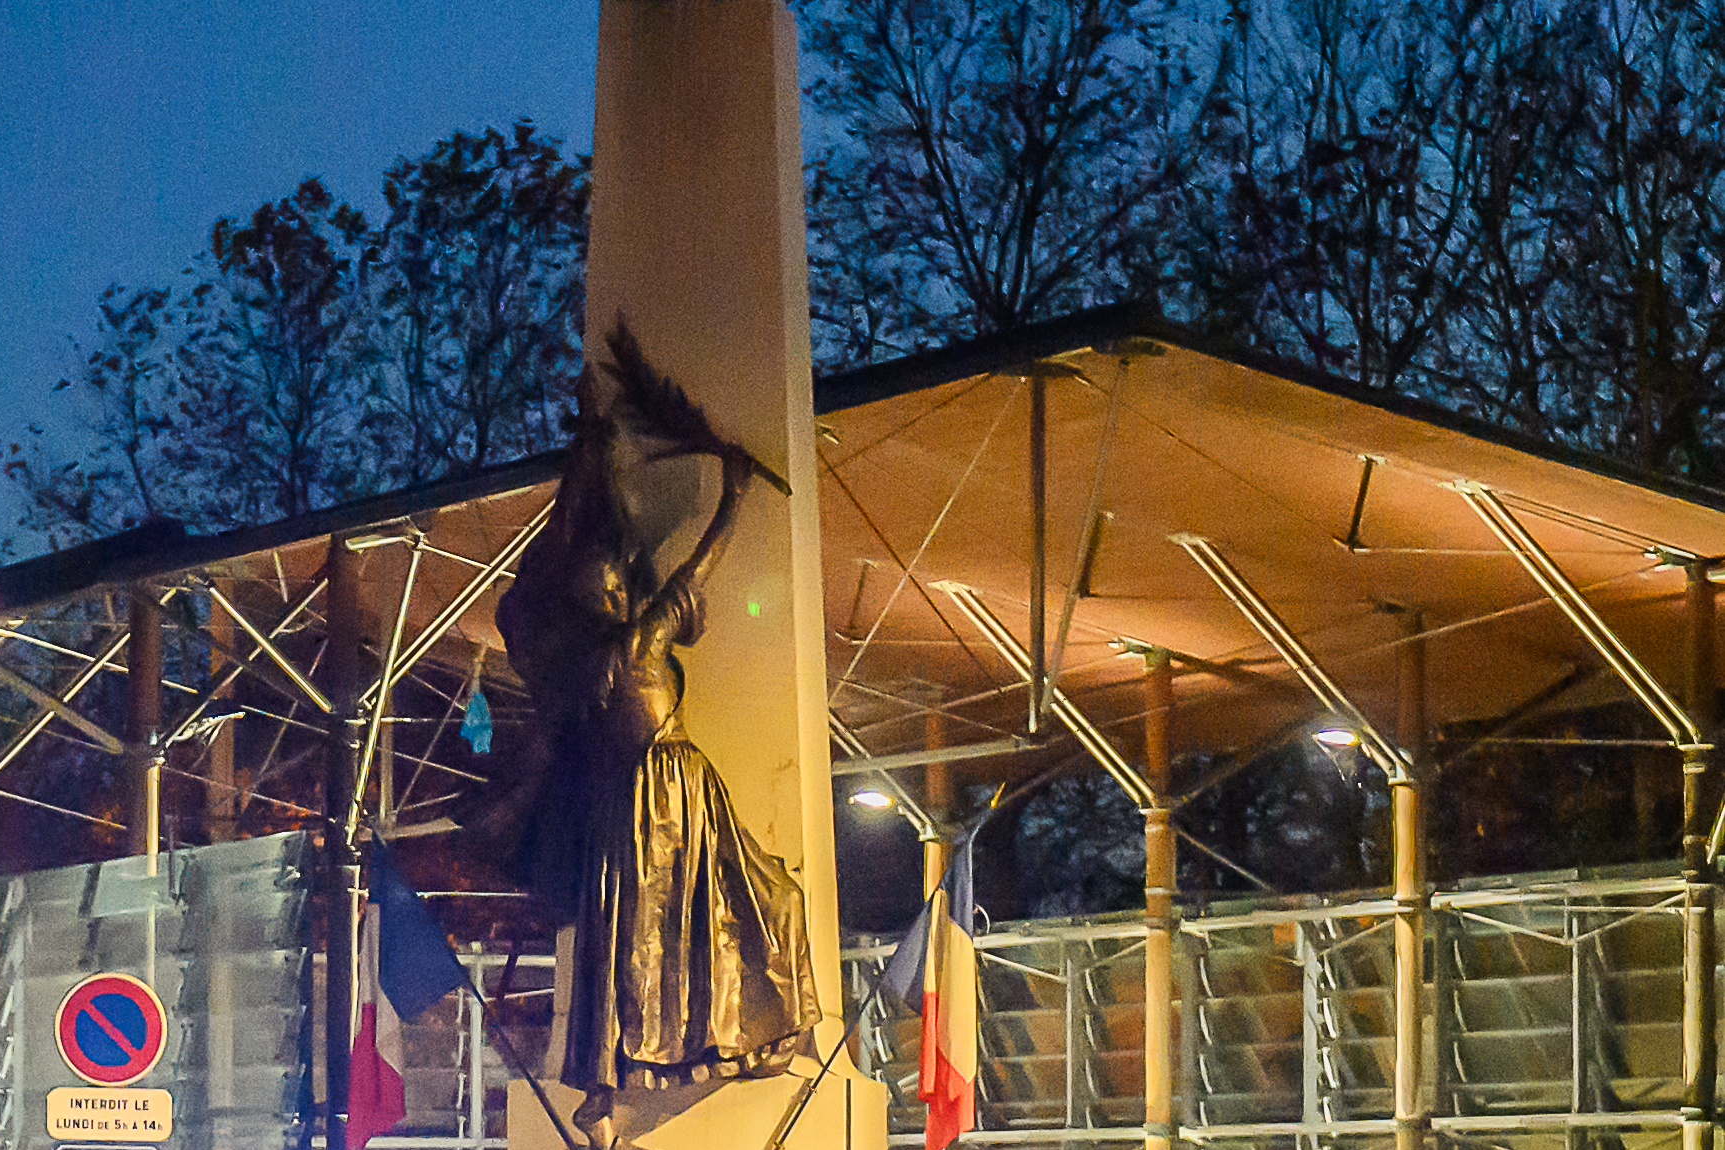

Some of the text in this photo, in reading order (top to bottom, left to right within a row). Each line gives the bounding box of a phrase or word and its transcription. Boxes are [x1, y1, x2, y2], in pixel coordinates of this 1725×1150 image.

[70, 1098, 149, 1111] INTERDIT LE
[56, 1118, 94, 1130] LUNDI
[98, 1121, 109, 1130] DE
